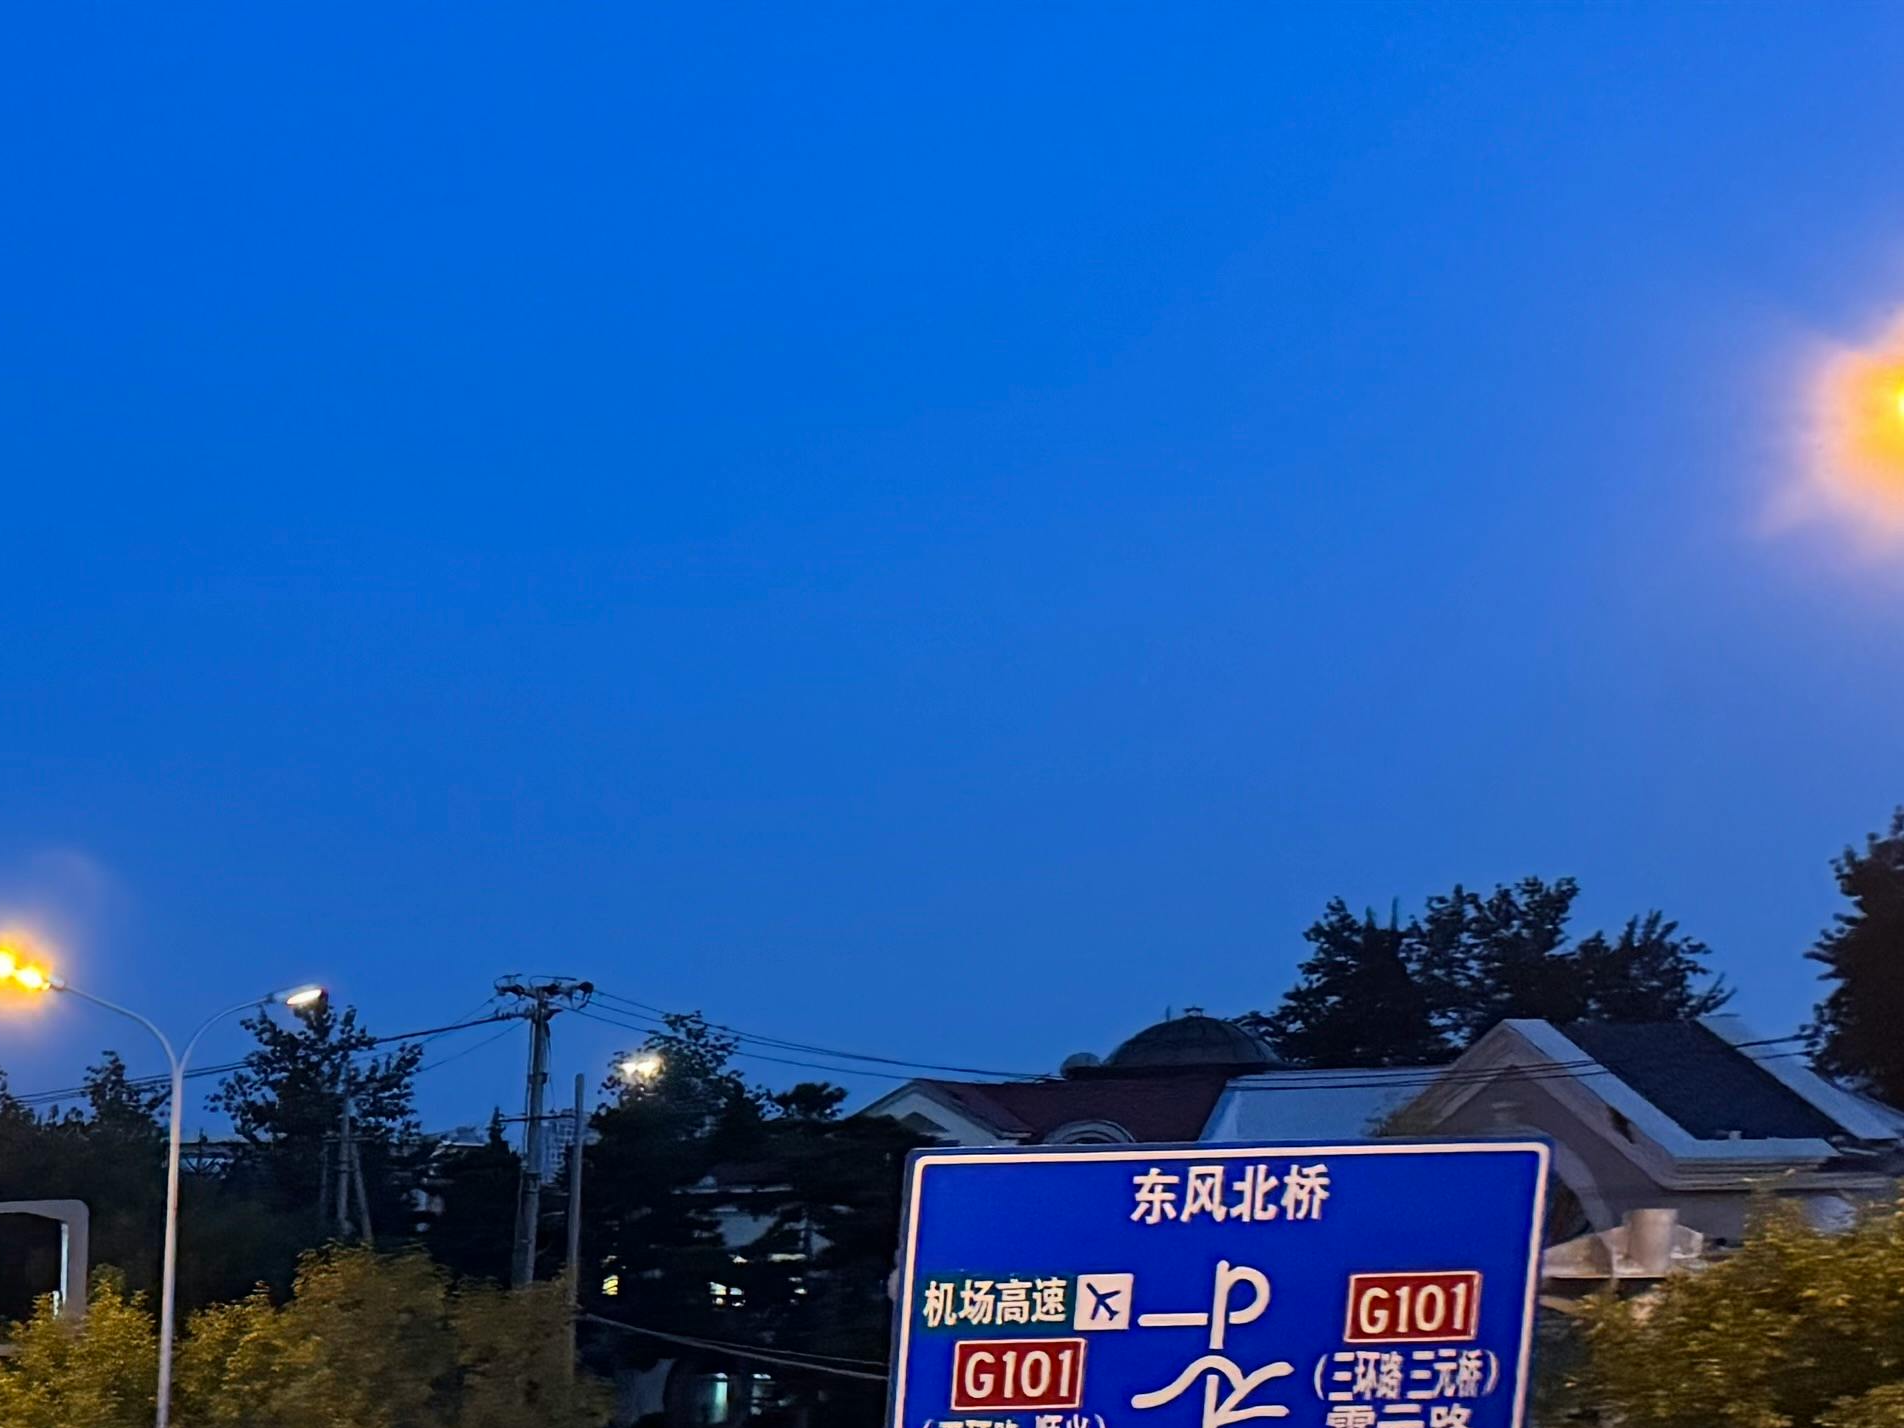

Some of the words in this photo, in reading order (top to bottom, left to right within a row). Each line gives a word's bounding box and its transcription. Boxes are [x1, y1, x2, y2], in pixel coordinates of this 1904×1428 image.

[1130, 1163, 1330, 1225] 东风北桥
[922, 1276, 1067, 1328] 机场高速
[1358, 1282, 1470, 1334] G101
[964, 1349, 1075, 1400] G101
